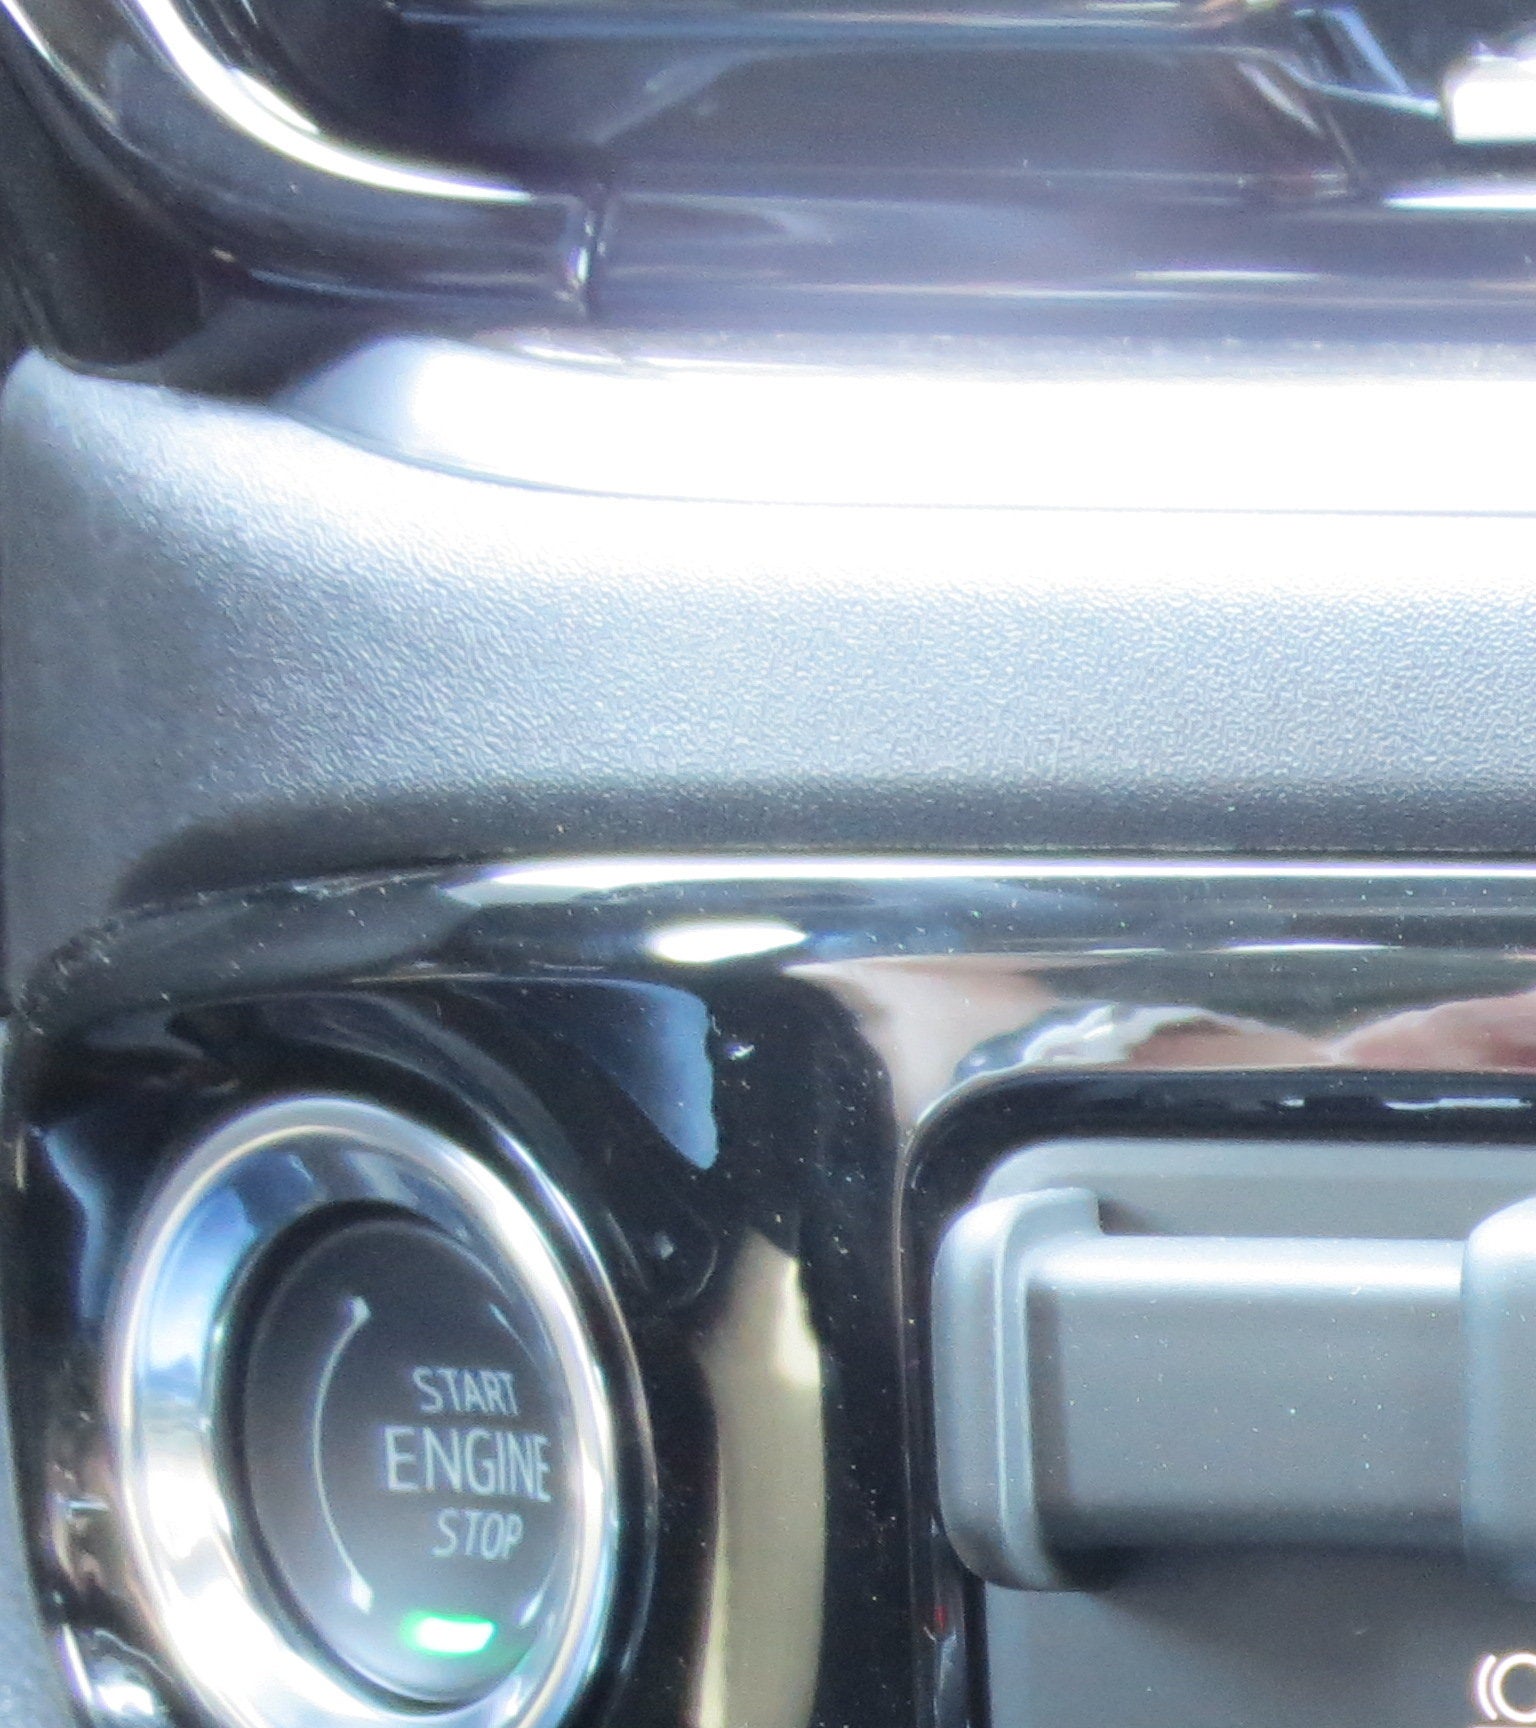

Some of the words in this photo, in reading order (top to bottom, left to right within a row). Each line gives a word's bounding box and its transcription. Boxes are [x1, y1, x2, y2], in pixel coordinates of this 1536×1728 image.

[412, 1366, 519, 1416] START
[384, 1424, 552, 1503] ENGINE
[431, 1507, 525, 1560] STOP
